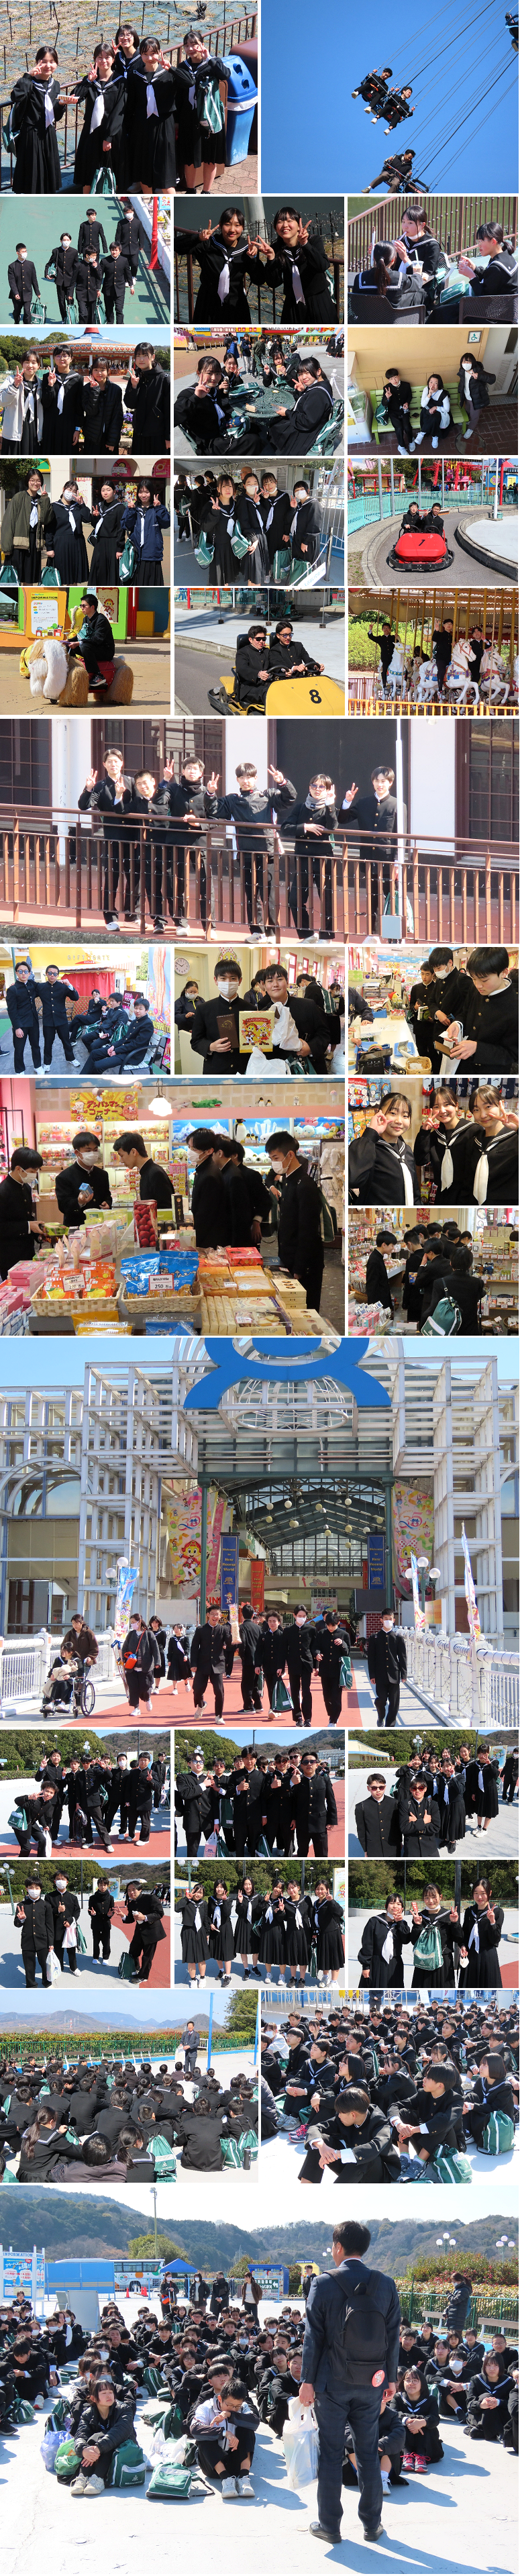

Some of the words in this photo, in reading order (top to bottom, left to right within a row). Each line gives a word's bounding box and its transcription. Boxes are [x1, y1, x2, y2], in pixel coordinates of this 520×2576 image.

[309, 689, 322, 704] 8
[87, 1101, 119, 1109] アンパンマン
